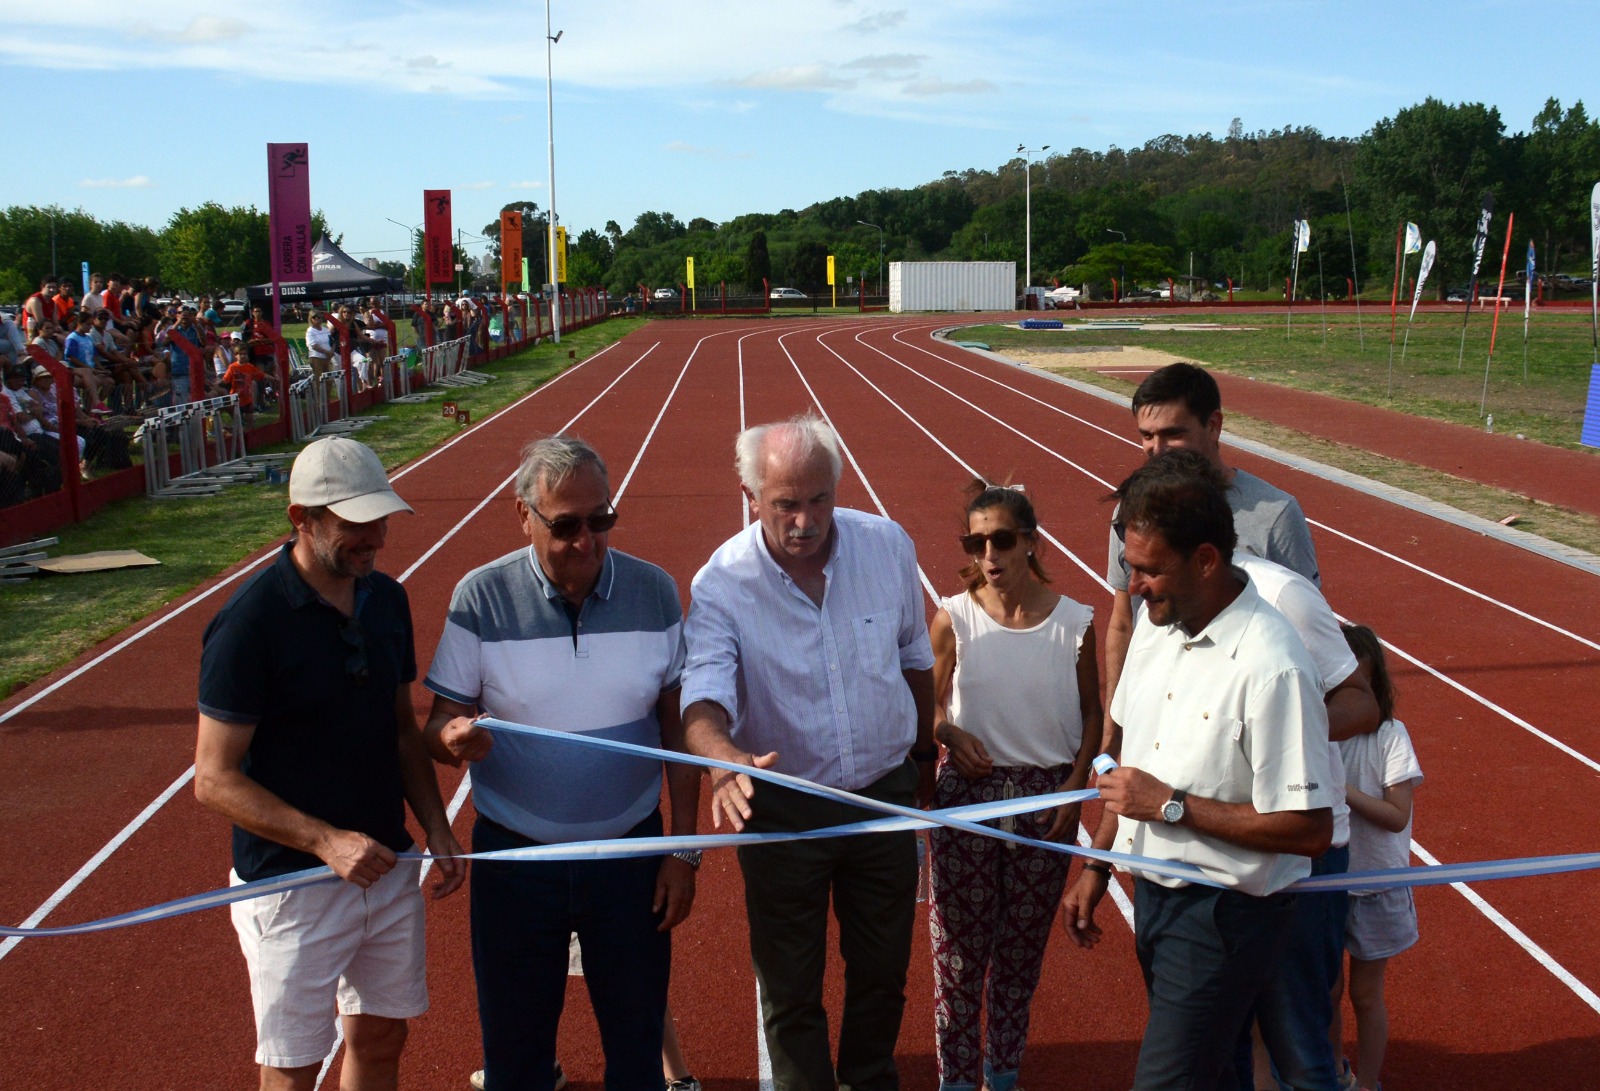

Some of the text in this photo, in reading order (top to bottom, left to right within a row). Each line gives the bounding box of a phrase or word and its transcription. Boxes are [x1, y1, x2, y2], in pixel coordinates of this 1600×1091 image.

[283, 235, 293, 274] CARRERA
[296, 224, 307, 274] CON VALLAS
[432, 236, 441, 277] LANZAMIENTO
[281, 286, 306, 295] DINAS
[444, 406, 455, 414] 20
[459, 414, 466, 422] 9
